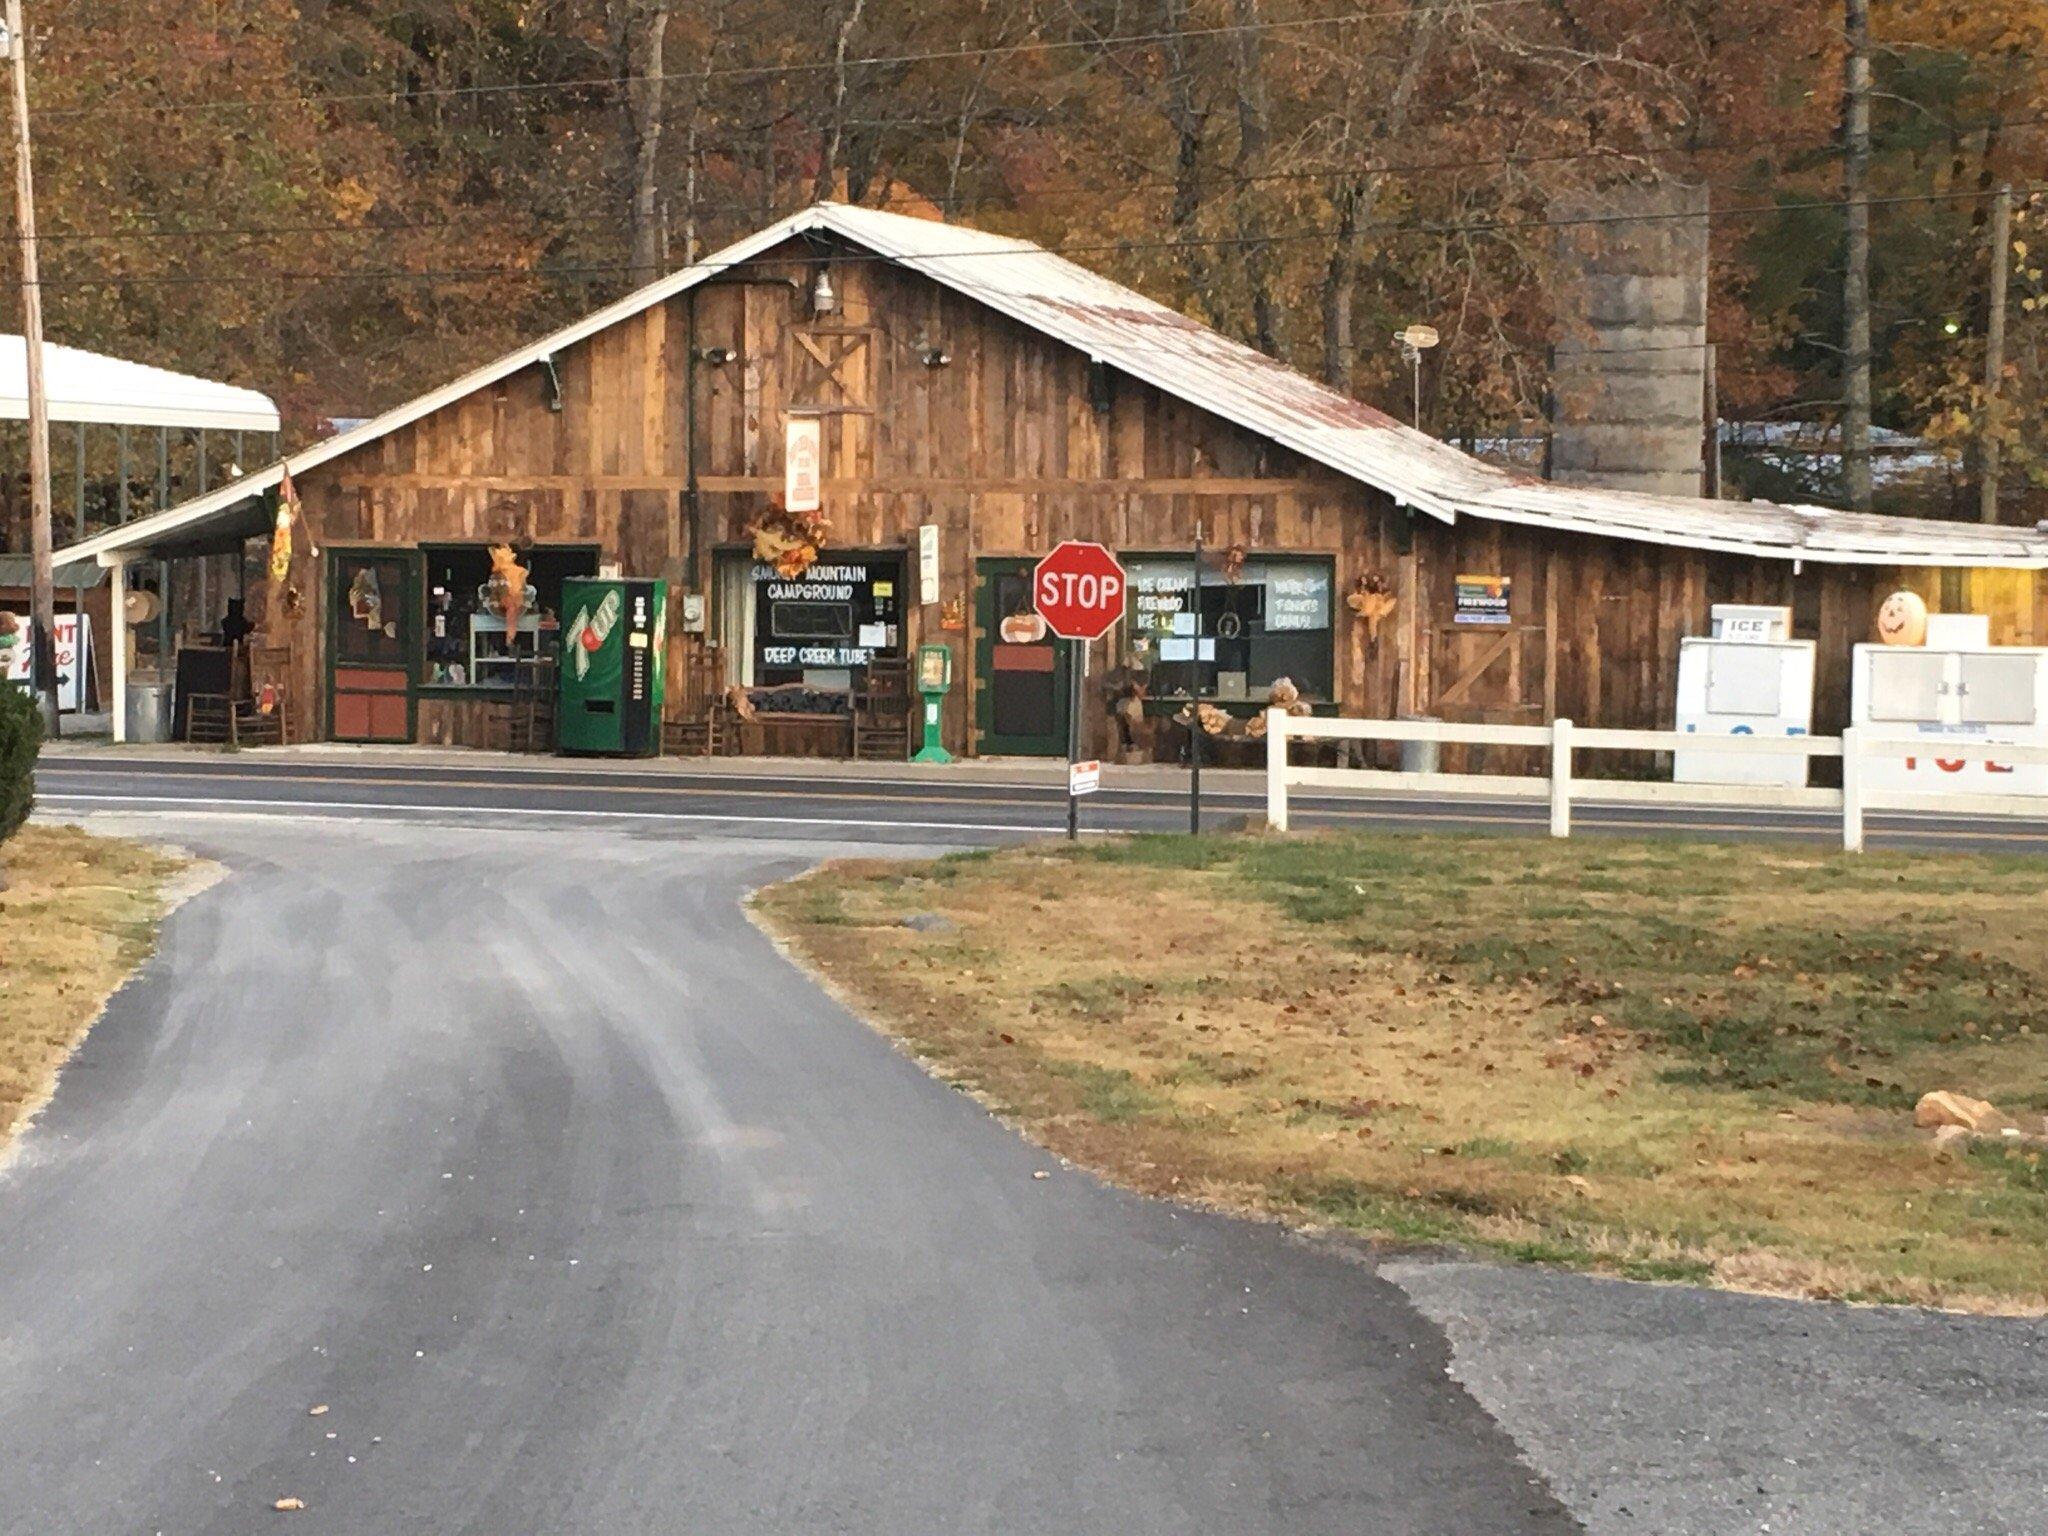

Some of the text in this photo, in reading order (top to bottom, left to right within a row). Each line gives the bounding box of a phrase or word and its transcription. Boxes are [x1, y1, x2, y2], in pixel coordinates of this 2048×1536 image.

[805, 565, 867, 582] MOUNTAIN
[767, 583, 854, 600] CAMPGROUND
[1041, 571, 1120, 610] STOP
[1730, 621, 1765, 632] ICE
[763, 646, 797, 663] DEEP
[798, 646, 836, 664] CREEK
